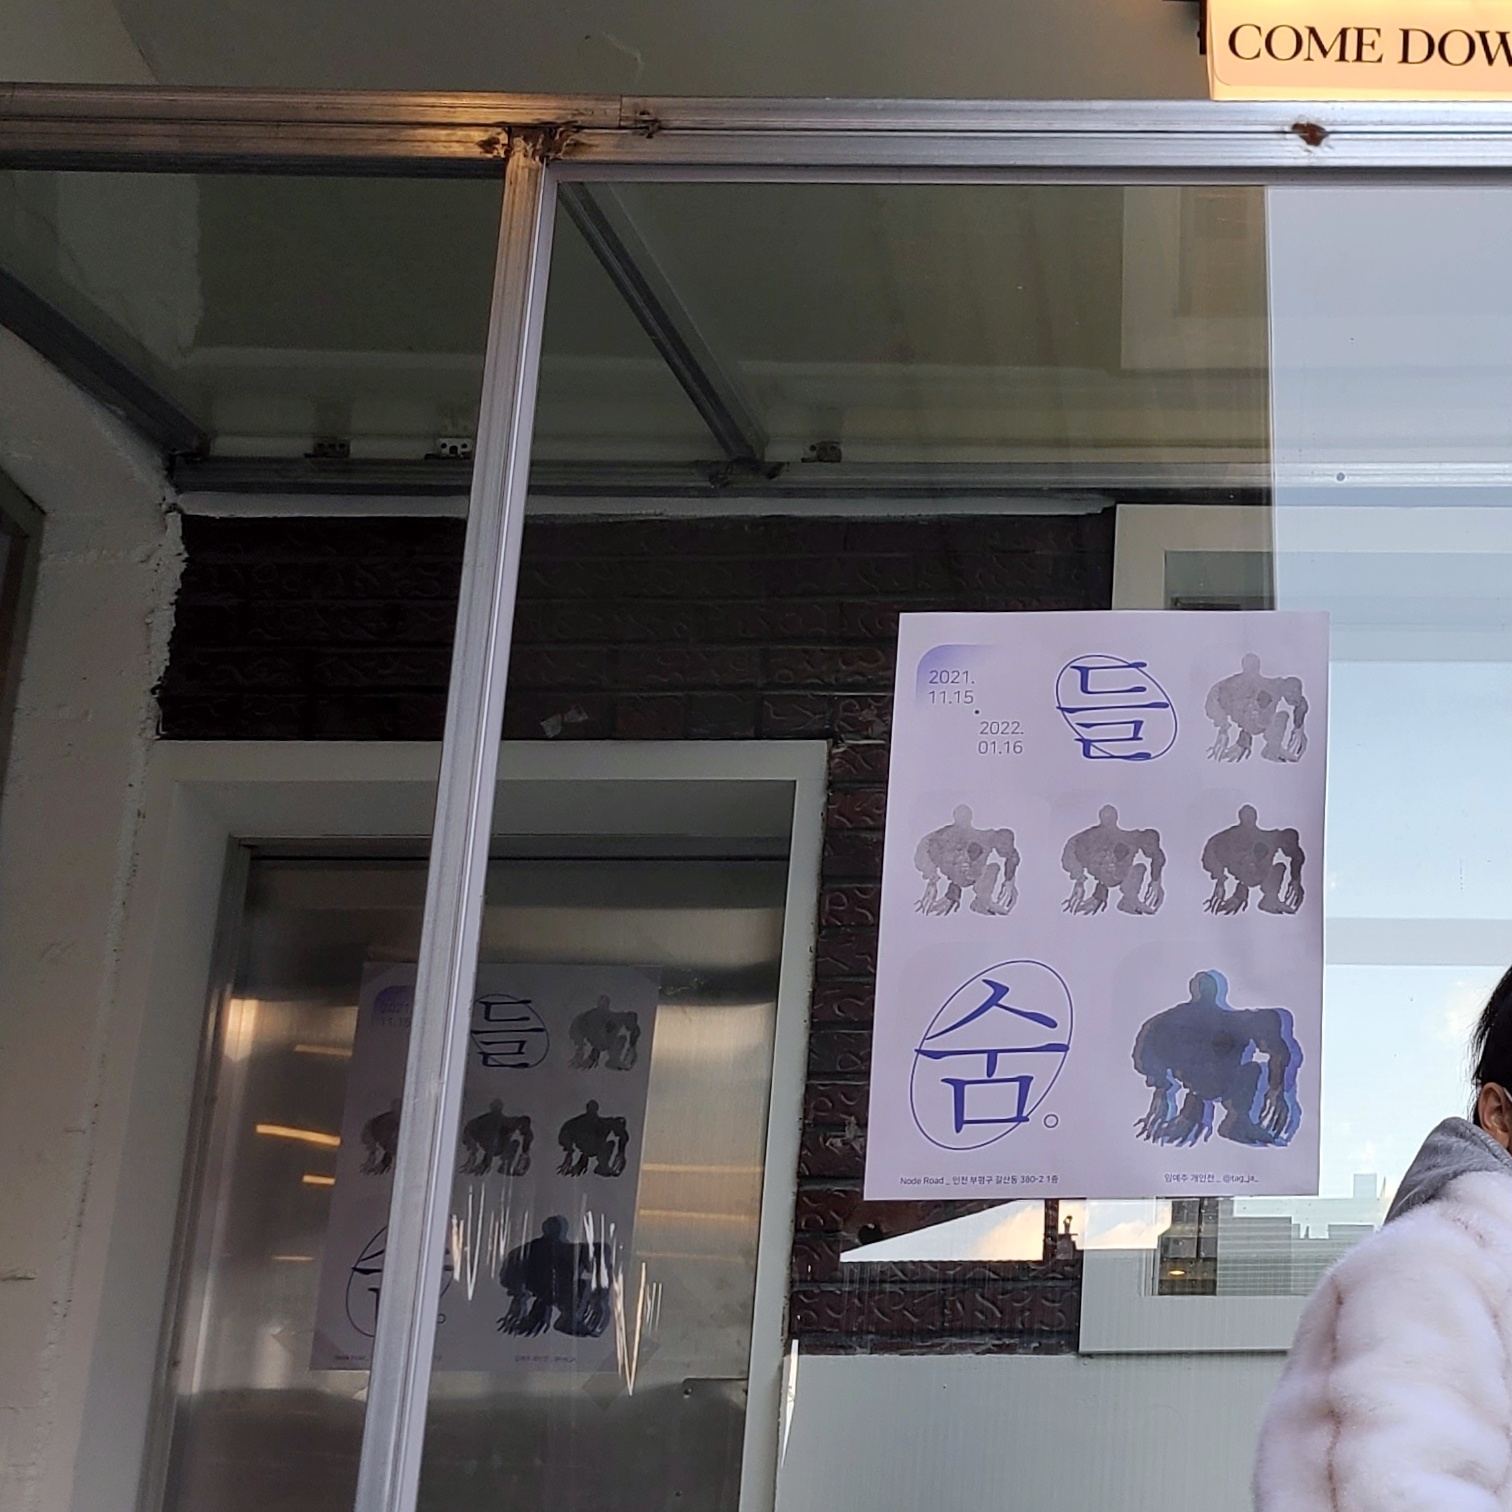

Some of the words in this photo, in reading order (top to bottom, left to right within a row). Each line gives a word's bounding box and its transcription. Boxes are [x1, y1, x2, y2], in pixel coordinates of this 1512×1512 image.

[1228, 23, 1384, 64] COME
[928, 669, 975, 685] 2021.
[928, 689, 975, 705] 11.15
[1056, 661, 1170, 761] 들
[979, 720, 1025, 736] 2022.
[977, 739, 1024, 755] 01.16
[900, 1176, 922, 1185] Node
[923, 1176, 945, 1185] Road
[952, 1175, 968, 1186] 인천
[970, 1175, 993, 1185] 부평구
